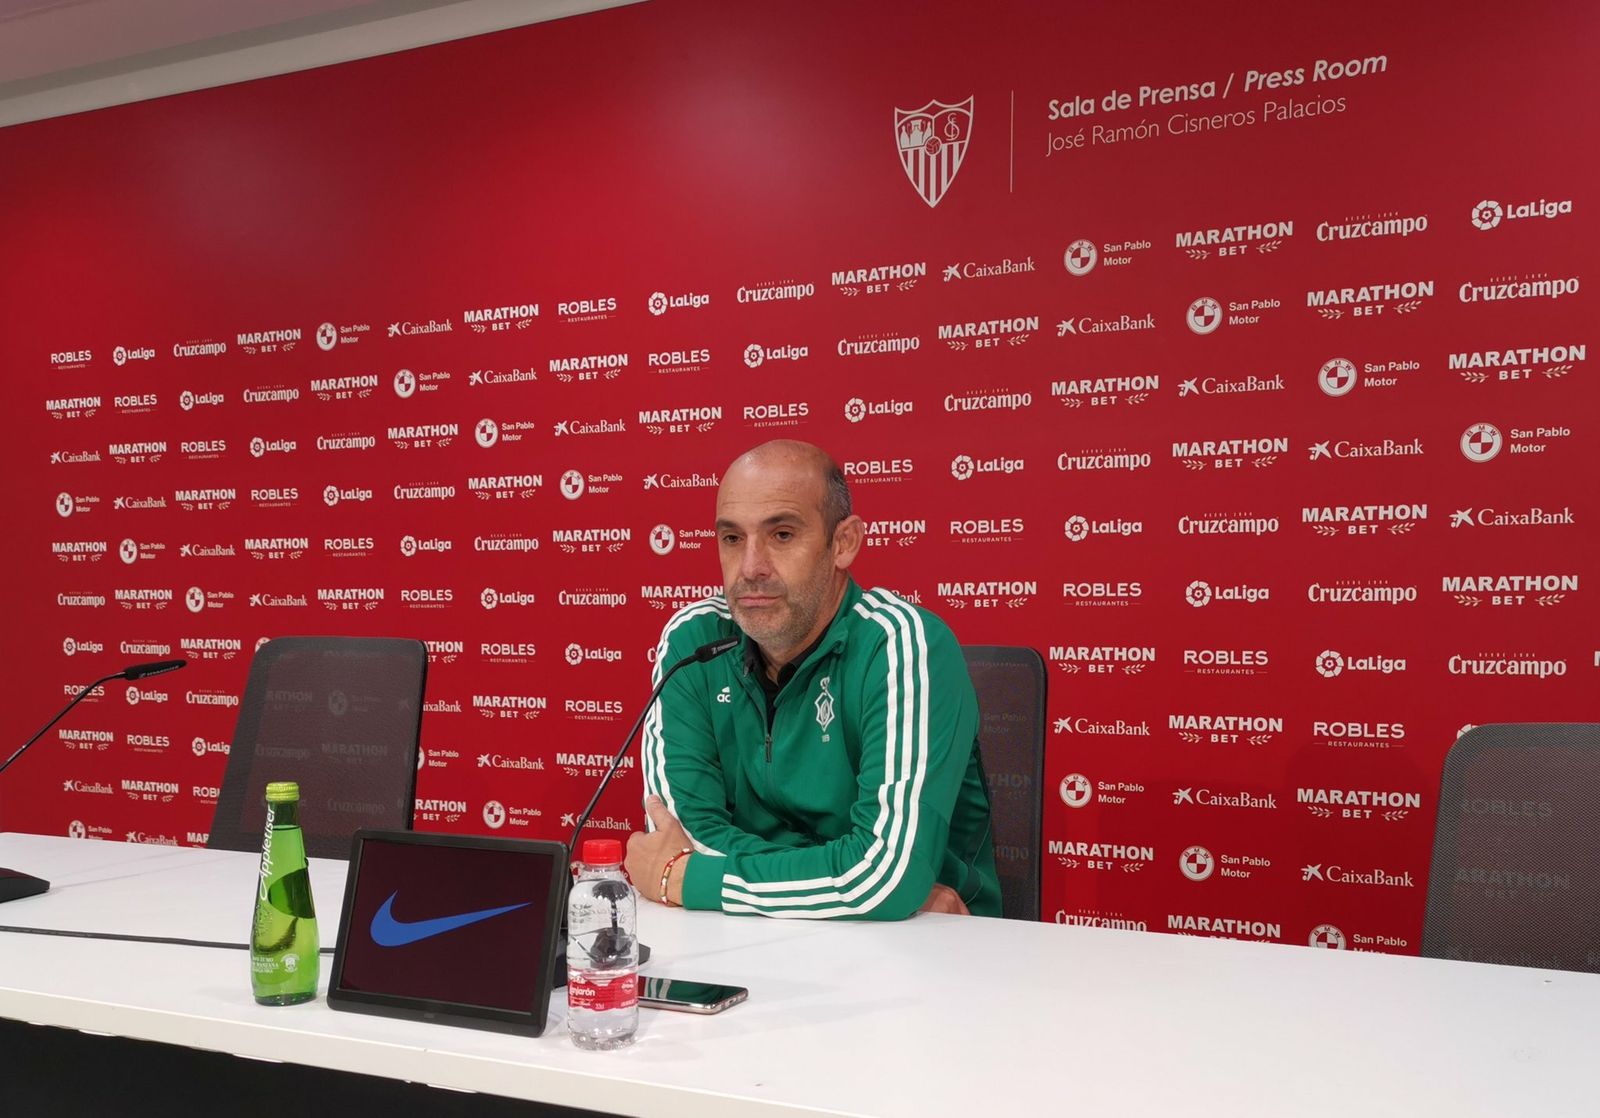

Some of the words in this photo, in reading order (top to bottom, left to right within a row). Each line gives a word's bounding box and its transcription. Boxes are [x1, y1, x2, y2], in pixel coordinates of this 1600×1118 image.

[1048, 96, 1094, 120] Sala
[1102, 90, 1131, 111] de
[1139, 82, 1215, 106] Prensa
[1223, 73, 1234, 98] /
[1245, 68, 1304, 92] Press
[1313, 56, 1387, 81] Room
[1046, 128, 1084, 157] José
[1093, 119, 1159, 144] Ramón
[1168, 111, 1255, 134] Cisneros
[1264, 95, 1345, 122] Palacios
[1507, 199, 1571, 219] LaLiga
[1176, 221, 1293, 249] MARATHON
[1317, 214, 1427, 241] Cruzcampo
[1104, 244, 1121, 252] San
[1124, 240, 1151, 250] Pablo
[1219, 245, 1247, 256] BET
[964, 257, 1035, 277] CaixaBank
[1104, 257, 1131, 266] Motor
[832, 263, 926, 287] MARATHON
[737, 284, 814, 303] Cruzcampo
[1307, 281, 1433, 308] MARATHON
[1460, 277, 1579, 302] Cruzcampo
[558, 298, 616, 315] ROBLES
[670, 293, 709, 308] LaLiga
[1229, 302, 1248, 311] San
[1252, 299, 1280, 309] Pablo
[464, 304, 538, 323] MARATHON
[1354, 305, 1384, 316] BET
[402, 319, 452, 334] CaixaBank
[1079, 314, 1155, 333] CaixaBank
[1229, 316, 1259, 325] Motor
[939, 317, 1038, 340] MARATHON
[238, 329, 301, 346] MARATHON
[976, 338, 999, 348] BET
[173, 343, 226, 357] Cruzcampo
[767, 345, 808, 360] LaLiga
[838, 337, 919, 355] Cruzcampo
[51, 350, 91, 363] ROBLES
[128, 348, 155, 360] LaLiga
[649, 349, 710, 366] ROBLES
[1449, 345, 1585, 371] MARATHON
[550, 354, 628, 373] MARATHON
[1365, 363, 1385, 372] San
[1389, 361, 1419, 371] Pablo
[484, 368, 537, 383] CaixaBank
[1499, 369, 1532, 380] BET
[311, 375, 377, 392] MARATHON
[1052, 375, 1158, 397] MARATHON
[1202, 375, 1284, 393] CaixaBank
[1365, 378, 1397, 387] Motor
[115, 394, 157, 407] ROBLES
[244, 389, 299, 402] Cruzcampo
[944, 393, 1031, 411] Cruzcampo
[46, 397, 100, 410] MARATHON
[744, 403, 808, 419] ROBLES
[869, 400, 912, 415] LaLiga
[639, 407, 721, 425] MARATHON
[388, 424, 458, 440] MARATHON
[570, 419, 625, 434] CaixaBank
[1511, 429, 1533, 438] San
[1537, 427, 1570, 437] Pablo
[109, 442, 166, 454] MARATHON
[181, 440, 226, 452] ROBLES
[266, 439, 296, 452] LaLiga
[317, 436, 375, 450] Cruzcampo
[1173, 438, 1287, 457] MARATHON
[1335, 439, 1423, 457] CaixaBank
[1511, 444, 1545, 453] Motor
[844, 459, 913, 475] ROBLES
[977, 457, 1024, 473] LaLiga
[1058, 453, 1150, 470] Cruzcampo
[469, 475, 542, 489] MARATHON
[661, 473, 719, 487] CaixaBank
[176, 489, 235, 504] MARATHON
[251, 488, 298, 500] ROBLES
[341, 488, 372, 501] LaLiga
[394, 485, 455, 500] Cruzcampo
[125, 497, 166, 508] CaixaBank
[1303, 504, 1427, 522] MARATHON
[1478, 507, 1574, 525] CaixaBank
[951, 519, 1023, 534] ROBLES
[1092, 519, 1142, 536] LaLiga
[1179, 516, 1278, 535] Cruzcampo
[553, 529, 630, 542] MARATHON
[52, 542, 106, 552] MARATHON
[192, 544, 235, 556] CaixaBank
[245, 538, 308, 549] MARATHON
[325, 538, 374, 549] ROBLES
[419, 538, 451, 552] LaLiga
[475, 536, 538, 552] Cruzcampo
[938, 582, 1036, 596] MARATHON
[1064, 583, 1141, 597] ROBLES
[1443, 575, 1578, 591] MARATHON
[115, 590, 172, 600] MARATHON
[318, 589, 384, 599] MARATHON
[401, 589, 453, 601] ROBLES
[500, 592, 534, 605] LaLiga
[559, 590, 626, 607] Cruzcampo
[641, 585, 723, 599] MARATHON
[1216, 585, 1269, 602] LaLiga
[1308, 583, 1417, 604] Cruzcampo
[58, 593, 105, 607] Cruzcampo
[262, 594, 307, 606] CaixaBank
[77, 641, 103, 653] LaLiga
[120, 641, 170, 656] Cruzcampo
[181, 639, 241, 649] MARATHON
[481, 644, 535, 655] ROBLES
[585, 648, 621, 662] LaLiga
[1050, 647, 1155, 661] MARATHON
[1184, 650, 1268, 665] ROBLES
[1348, 655, 1406, 673] LaLiga
[1449, 655, 1566, 678] Cruzcampo
[141, 690, 168, 703] LaLiga
[186, 691, 239, 707] Cruzcampo
[473, 696, 546, 708] MARATHON
[566, 700, 622, 713] ROBLES
[1075, 719, 1150, 735] CaixaBank
[1169, 715, 1282, 732] MARATHON
[1314, 722, 1404, 738] ROBLES
[59, 730, 113, 743] MARATHON
[127, 735, 169, 746] ROBLES
[492, 755, 544, 769] CaixaBank
[122, 780, 178, 795] MARATHON
[1098, 782, 1115, 790] San
[1118, 783, 1144, 792] Pablo
[1098, 794, 1126, 803] Motor
[1196, 790, 1276, 808] CaixaBank
[1297, 788, 1420, 810] MARATHON
[1343, 809, 1372, 818] BET
[1049, 841, 1153, 862] MARATHON
[1088, 860, 1112, 870] BET
[1221, 855, 1239, 864] San
[1243, 856, 1270, 866] Pablo
[1221, 868, 1250, 878] Motor
[1327, 866, 1413, 887] CaixaBank
[1168, 915, 1280, 937] MARATHON
[1354, 934, 1373, 943] San
[1377, 936, 1407, 946] Pablo
